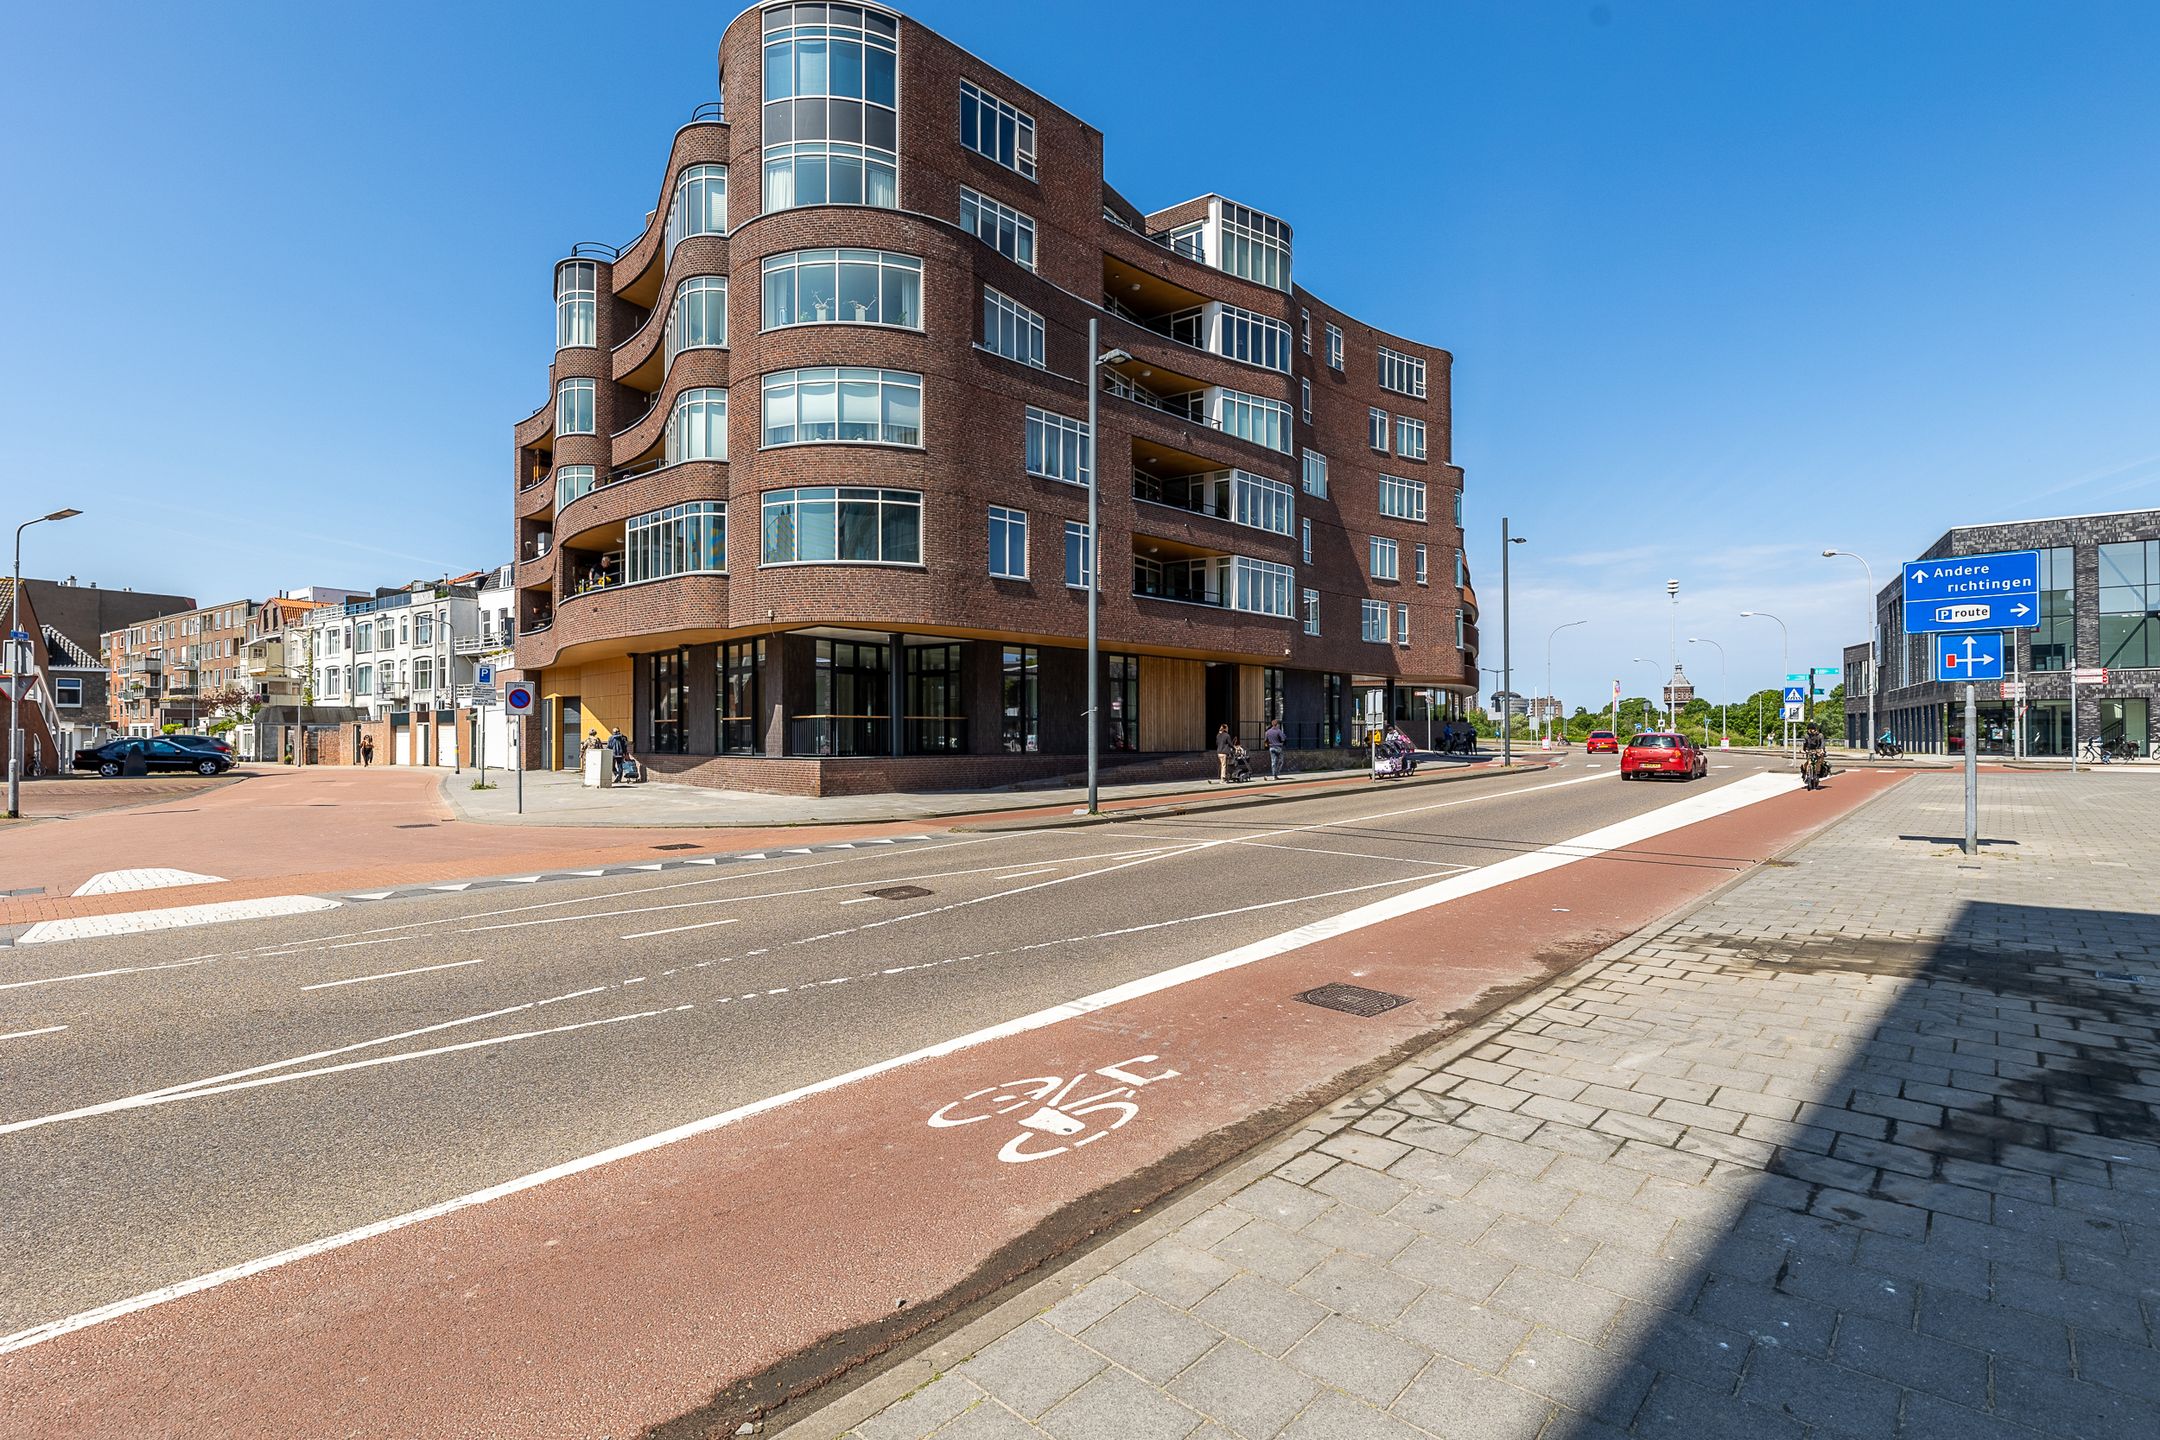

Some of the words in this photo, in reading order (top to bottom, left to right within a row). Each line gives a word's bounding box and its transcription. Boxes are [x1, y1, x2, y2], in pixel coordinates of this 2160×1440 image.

[1933, 565, 1990, 578] Andere
[1947, 578, 2032, 592] richtingen
[1940, 610, 1949, 620] P
[1954, 607, 1989, 617] route
[481, 669, 489, 677] P
